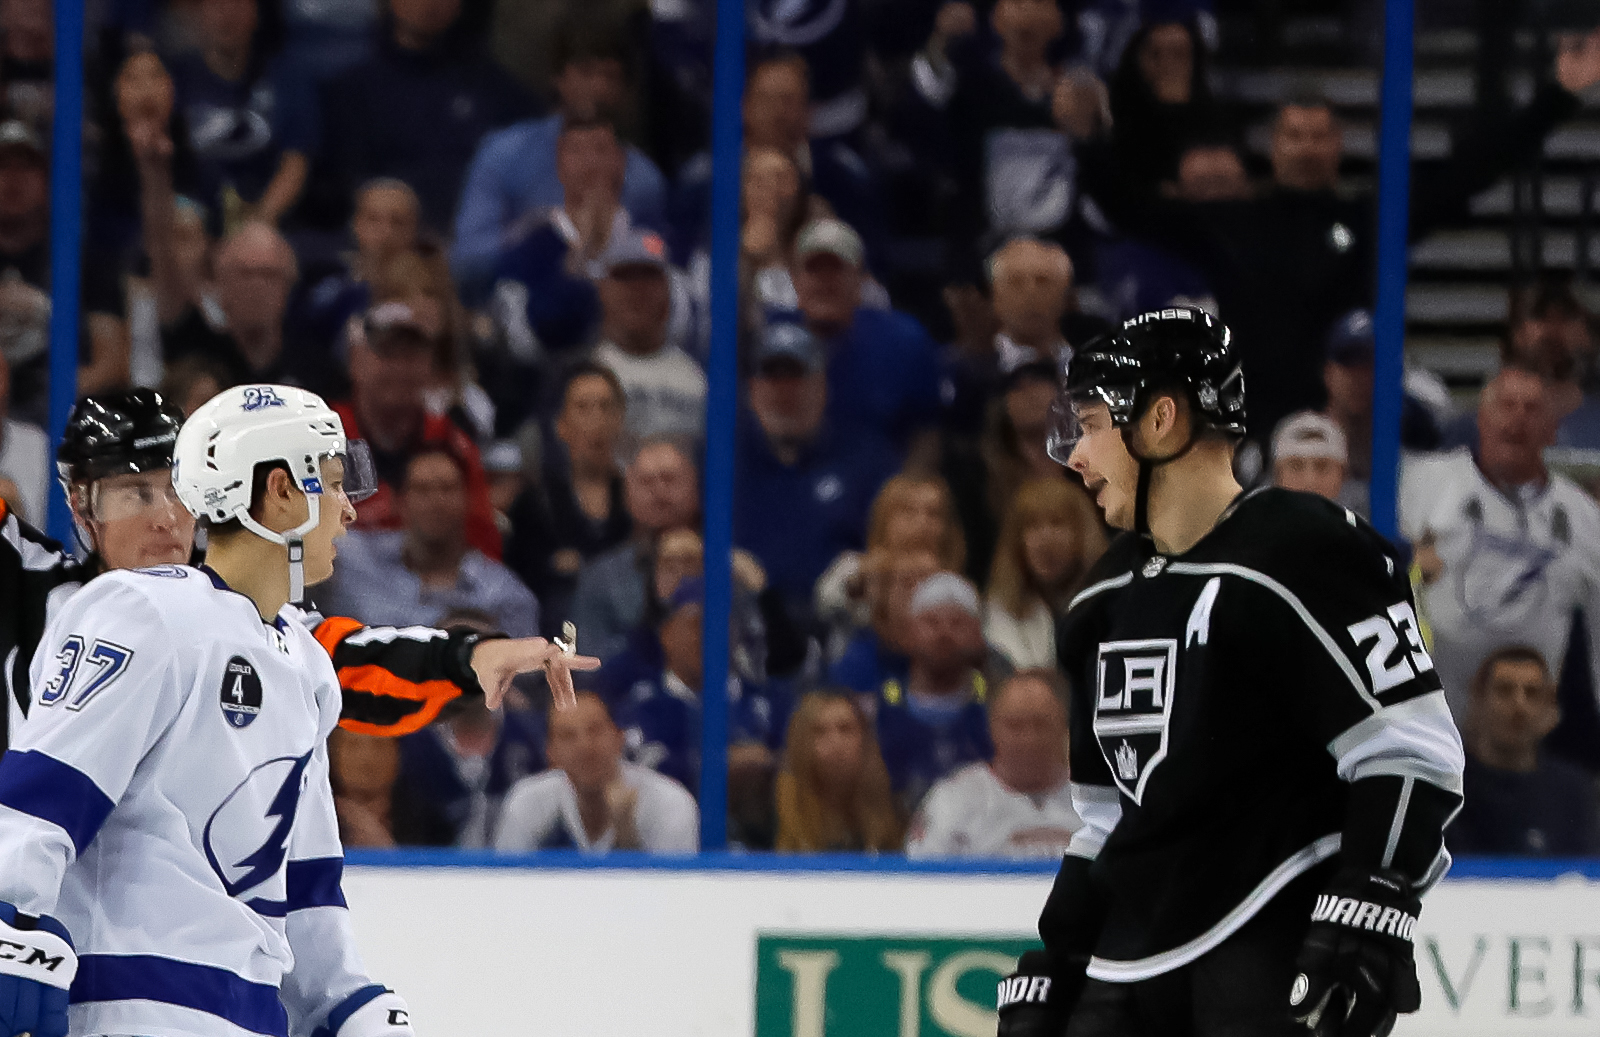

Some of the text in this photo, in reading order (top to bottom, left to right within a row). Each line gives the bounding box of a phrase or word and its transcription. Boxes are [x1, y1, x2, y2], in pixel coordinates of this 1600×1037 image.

[1185, 576, 1221, 650] A
[1346, 600, 1434, 696] 23
[39, 634, 134, 712] 37
[232, 674, 244, 704] 4
[1099, 655, 1166, 710] LA
